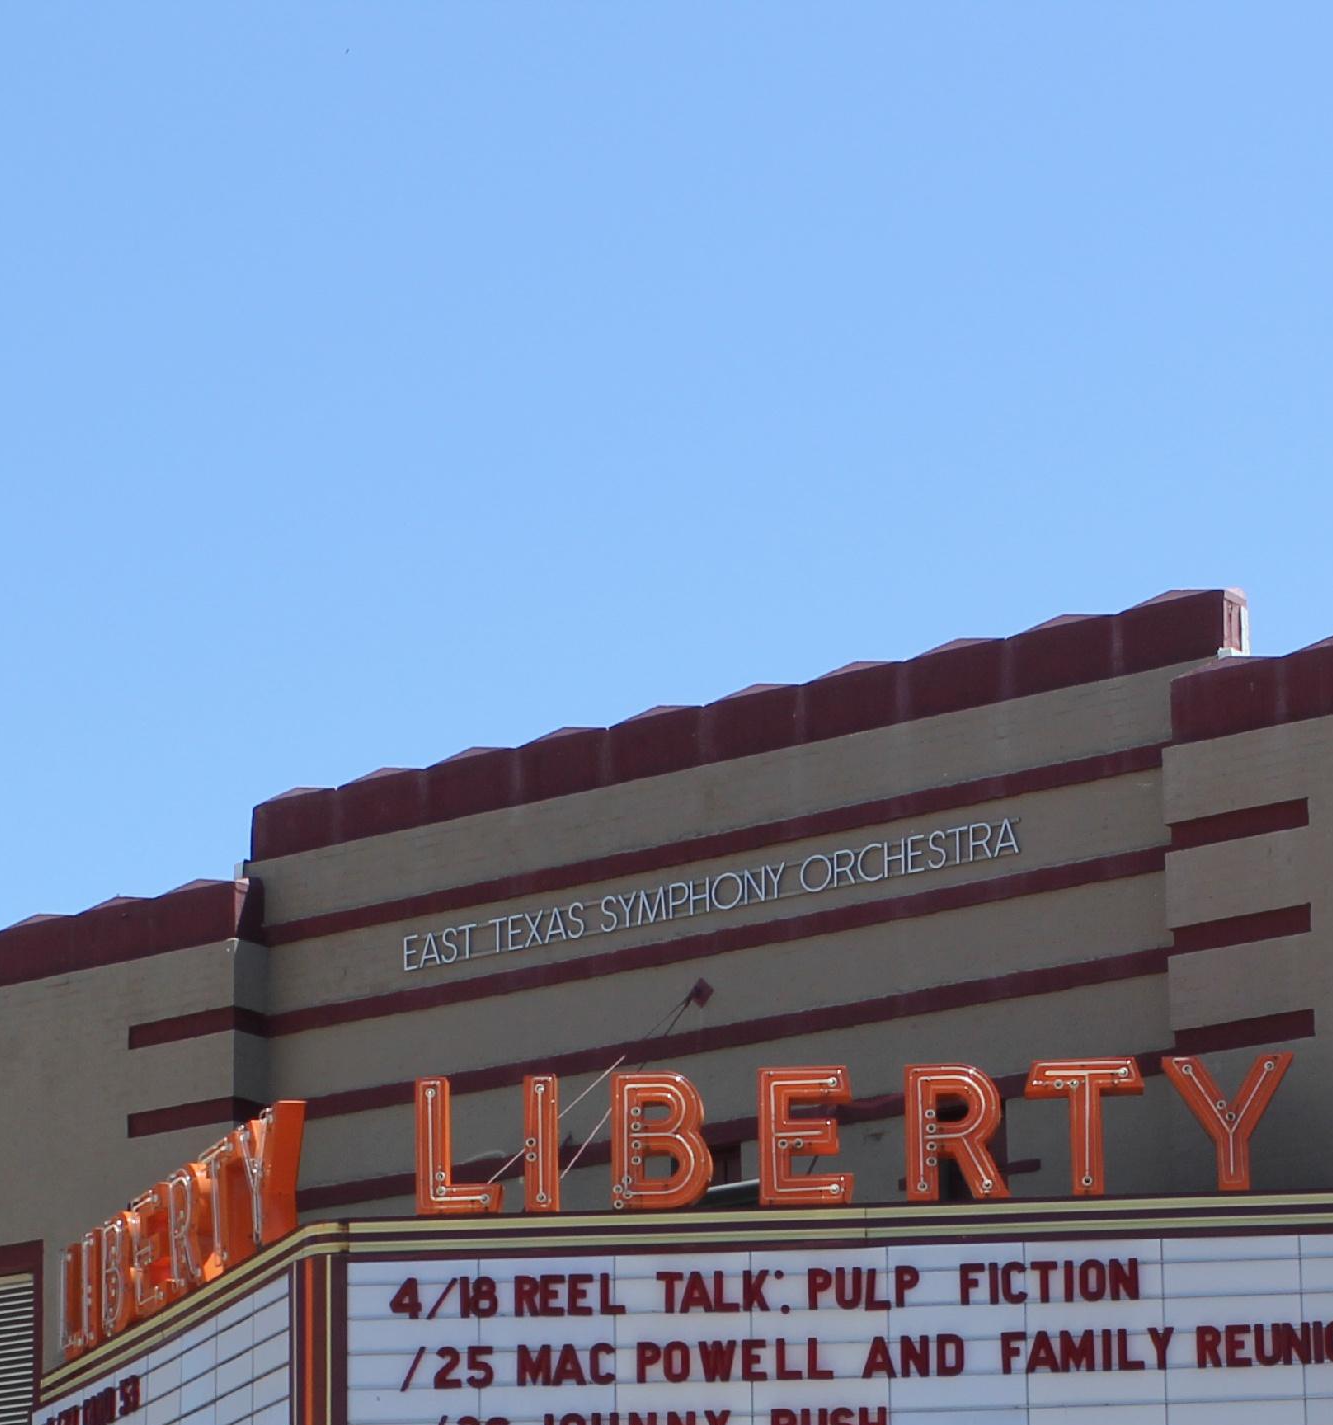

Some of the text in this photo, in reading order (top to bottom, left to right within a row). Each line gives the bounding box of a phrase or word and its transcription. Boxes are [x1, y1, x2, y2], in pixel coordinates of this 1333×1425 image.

[403, 817, 1023, 972] EAST TEXAS SYMPHONY ORCHESTRA
[415, 1050, 1294, 1216] LIBERTY
[58, 1099, 308, 1360] LIBERTY
[389, 1276, 498, 1320] 4/18
[514, 1272, 626, 1316] REEL
[807, 1265, 920, 1311] PULP
[960, 1257, 1140, 1306] FICTION
[400, 1344, 495, 1393] /25
[516, 1342, 616, 1388] MAC
[636, 1335, 835, 1384] POWELL
[864, 1332, 965, 1379] AND
[1001, 1325, 1175, 1375] FAMILY
